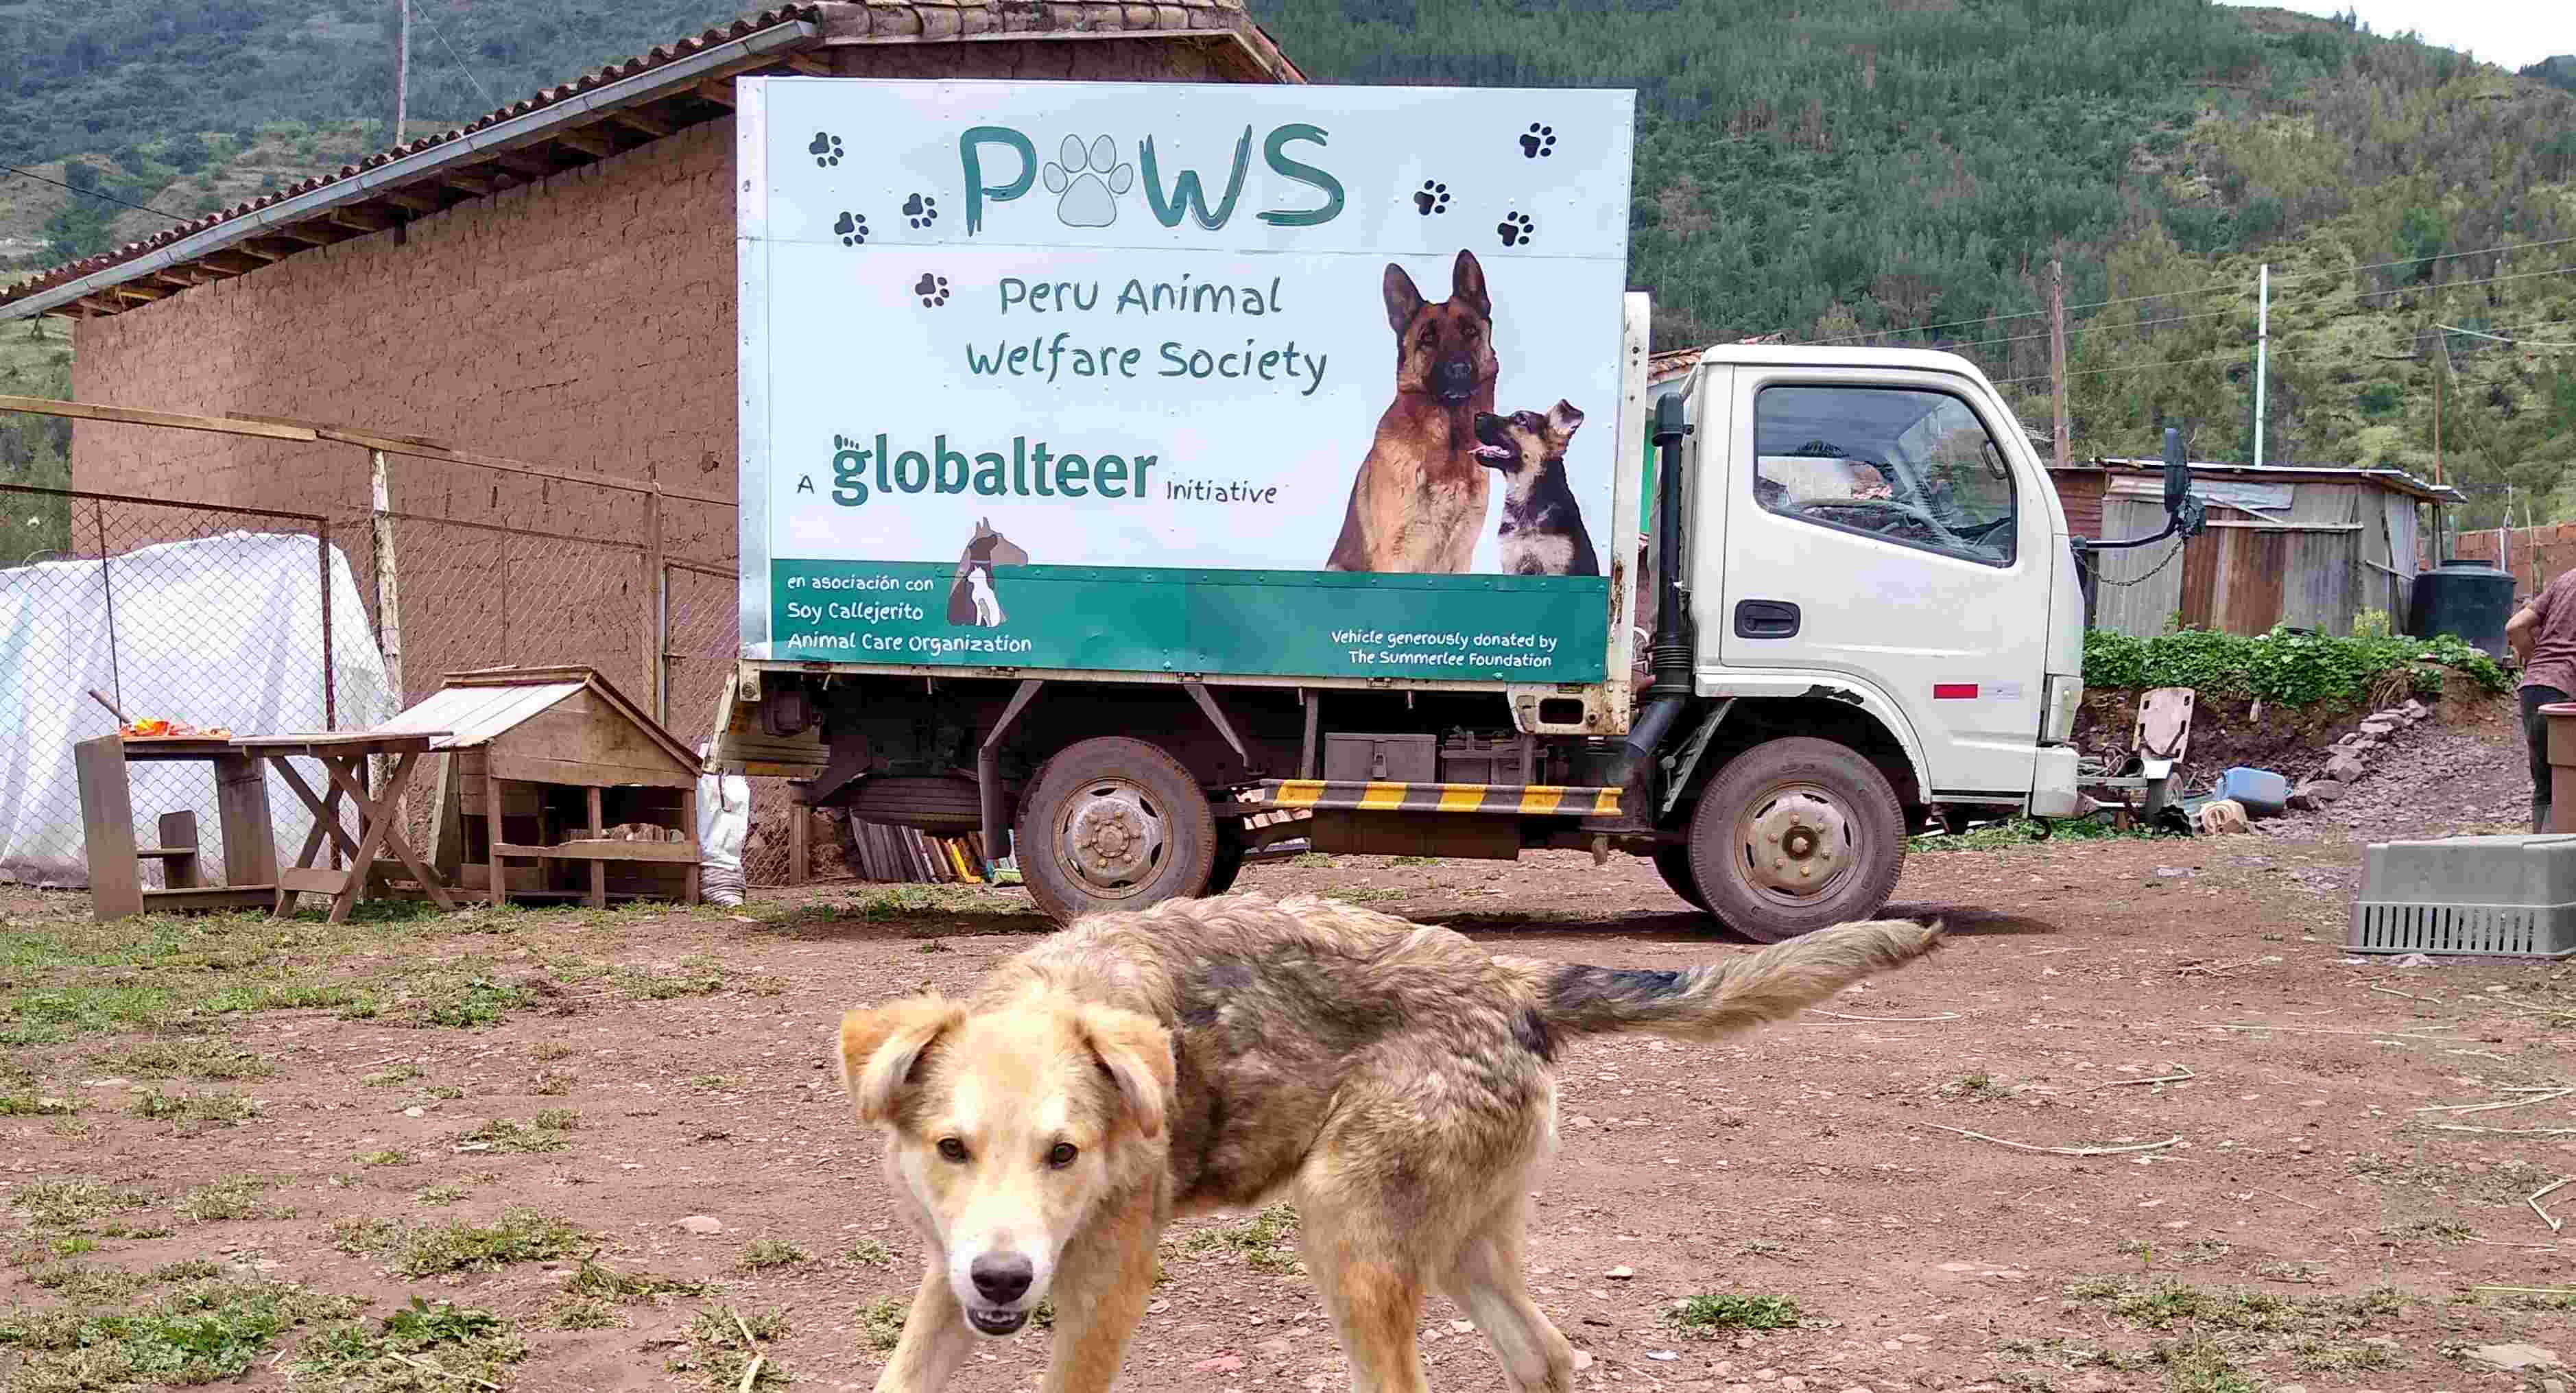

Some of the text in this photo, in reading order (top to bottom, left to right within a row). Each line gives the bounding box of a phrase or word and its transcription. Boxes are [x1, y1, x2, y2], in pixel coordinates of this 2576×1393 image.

[960, 123, 1344, 237] PWS
[1000, 274, 1282, 315] Peru Animal
[966, 333, 1326, 396] Welfare Society
[798, 433, 1276, 506] A globalteer Initiative
[788, 575, 933, 591] en asociación con
[789, 602, 922, 623] Soy Callejerito
[787, 632, 1031, 656] Animal Care Organization
[1332, 630, 1556, 652] Vehicle generously donated by
[1349, 650, 1551, 667] The Summerlee Foundation
